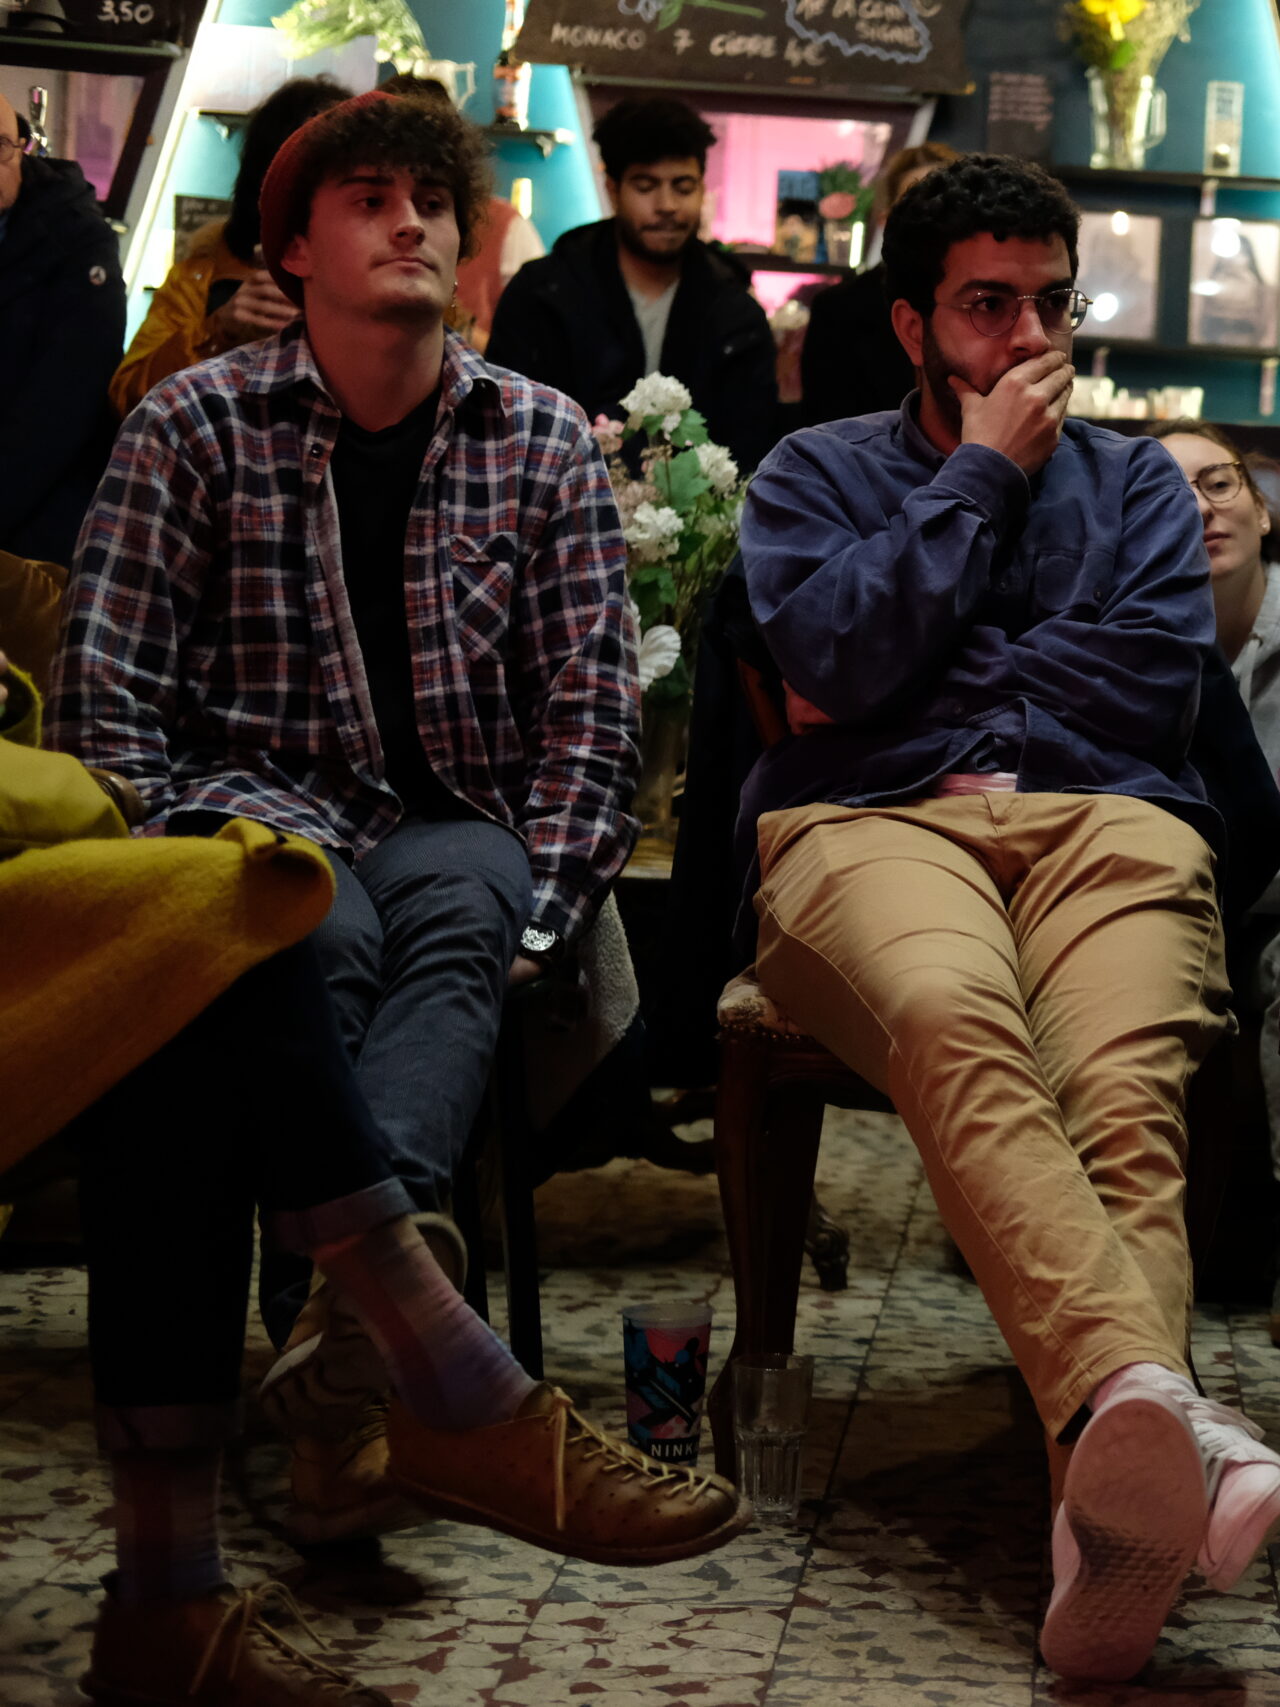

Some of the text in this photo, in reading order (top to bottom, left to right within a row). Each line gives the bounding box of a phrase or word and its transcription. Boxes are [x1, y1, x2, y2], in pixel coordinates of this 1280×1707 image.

[97, 0, 155, 24] 3,50
[550, 23, 647, 51] MONACO
[651, 1442, 696, 1458] NINK
